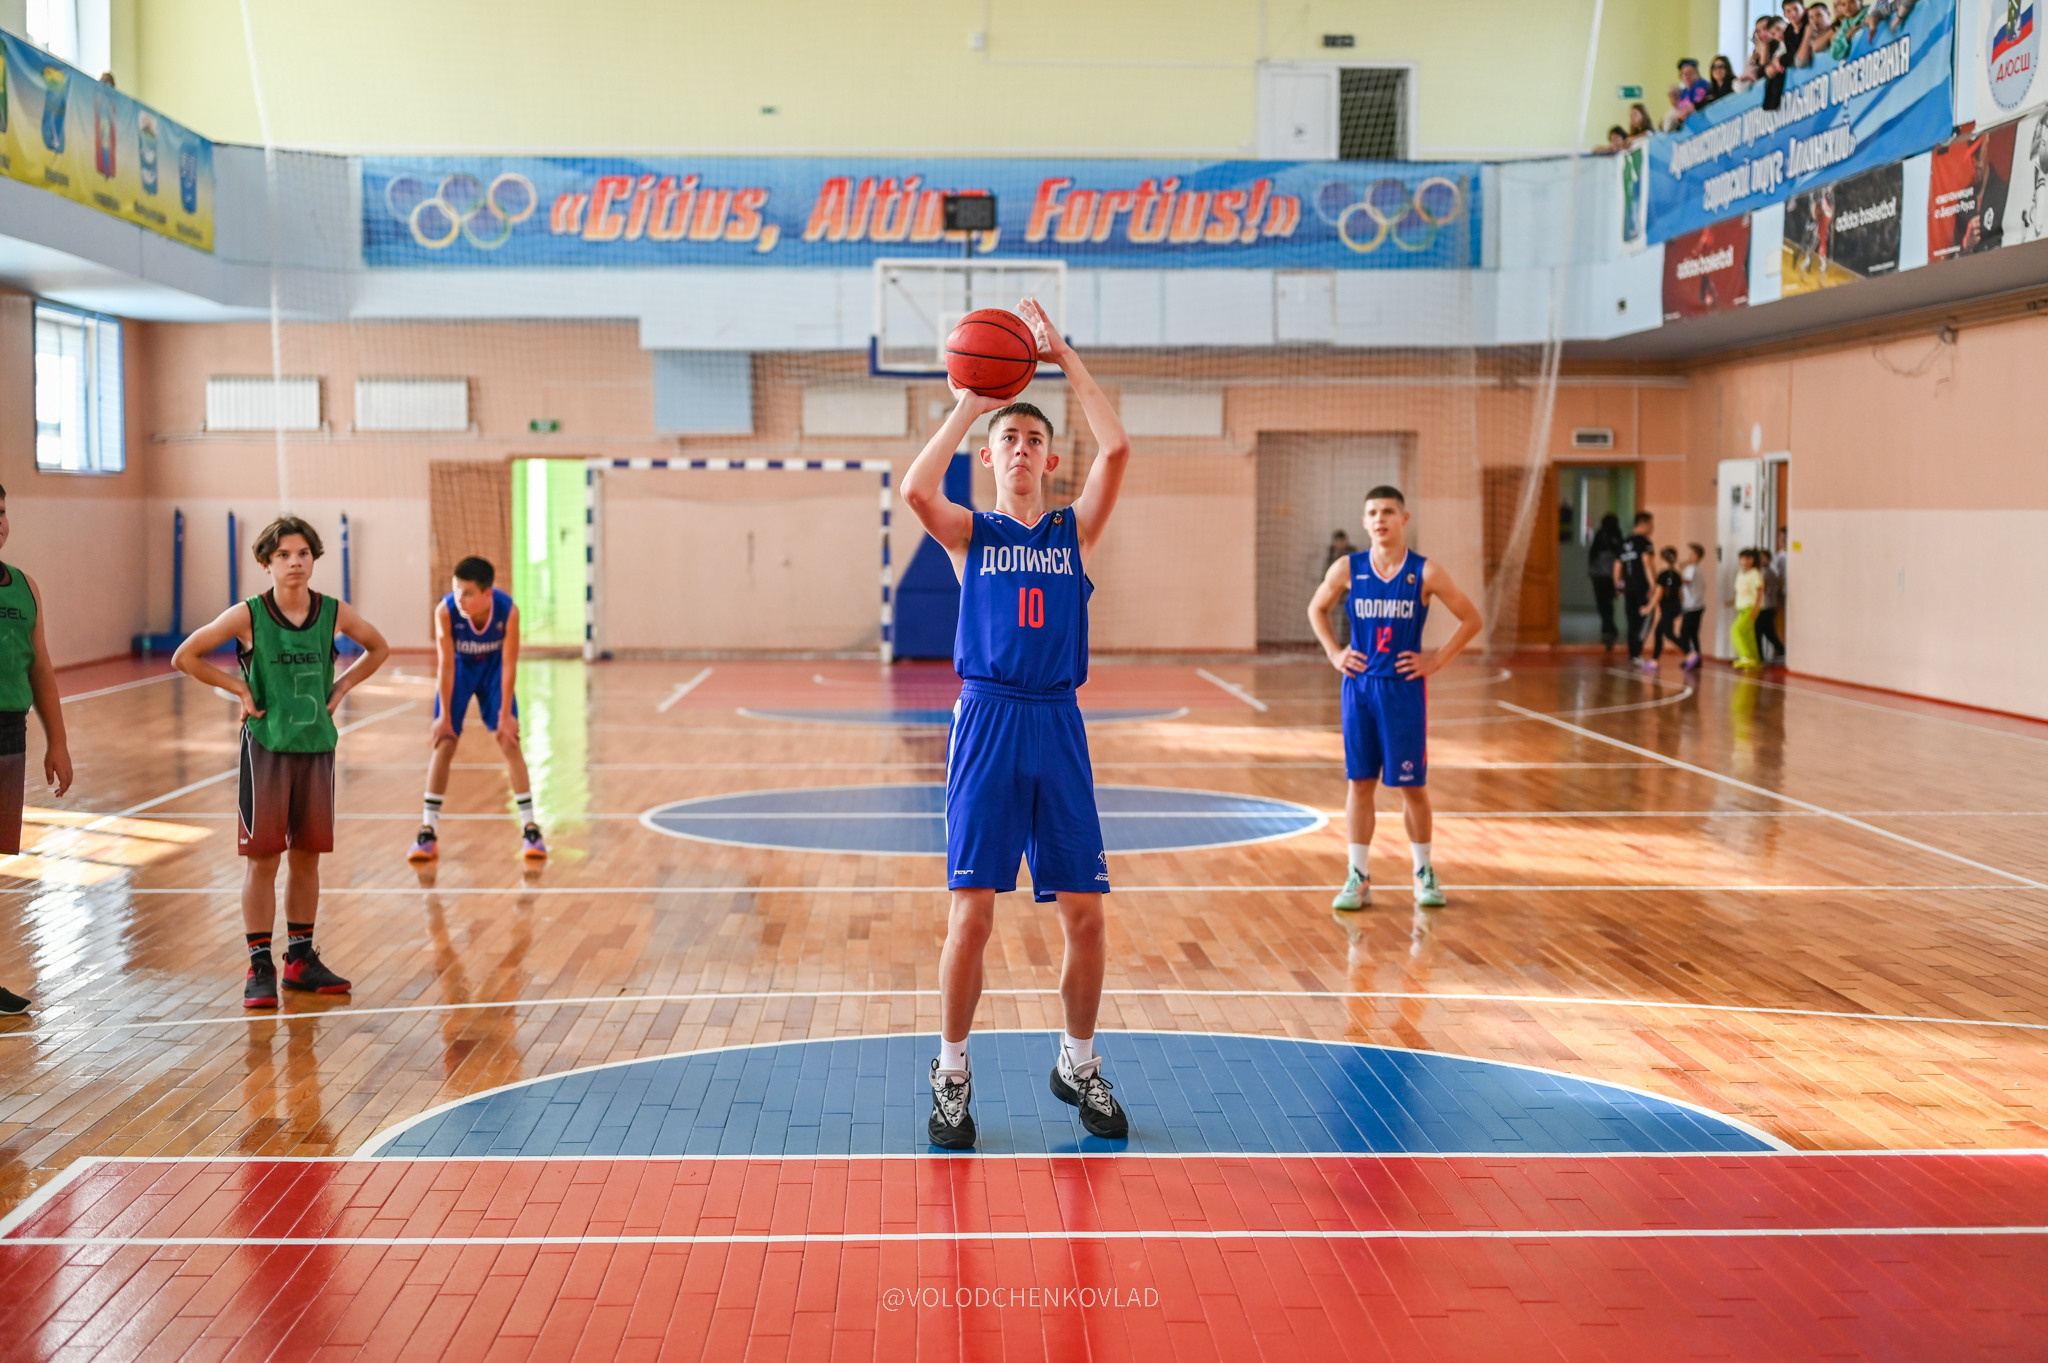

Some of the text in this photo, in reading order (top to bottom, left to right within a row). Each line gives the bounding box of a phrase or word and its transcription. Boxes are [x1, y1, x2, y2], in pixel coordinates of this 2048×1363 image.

[1995, 52, 2031, 83] ДЮСШ
[550, 173, 780, 253] «Citius,
[1025, 175, 1301, 244] Fortius!»
[980, 545, 1073, 576] ДОЛИНСК
[1018, 587, 1045, 628] 10
[1376, 626, 1393, 653] 12
[289, 671, 321, 725] 5
